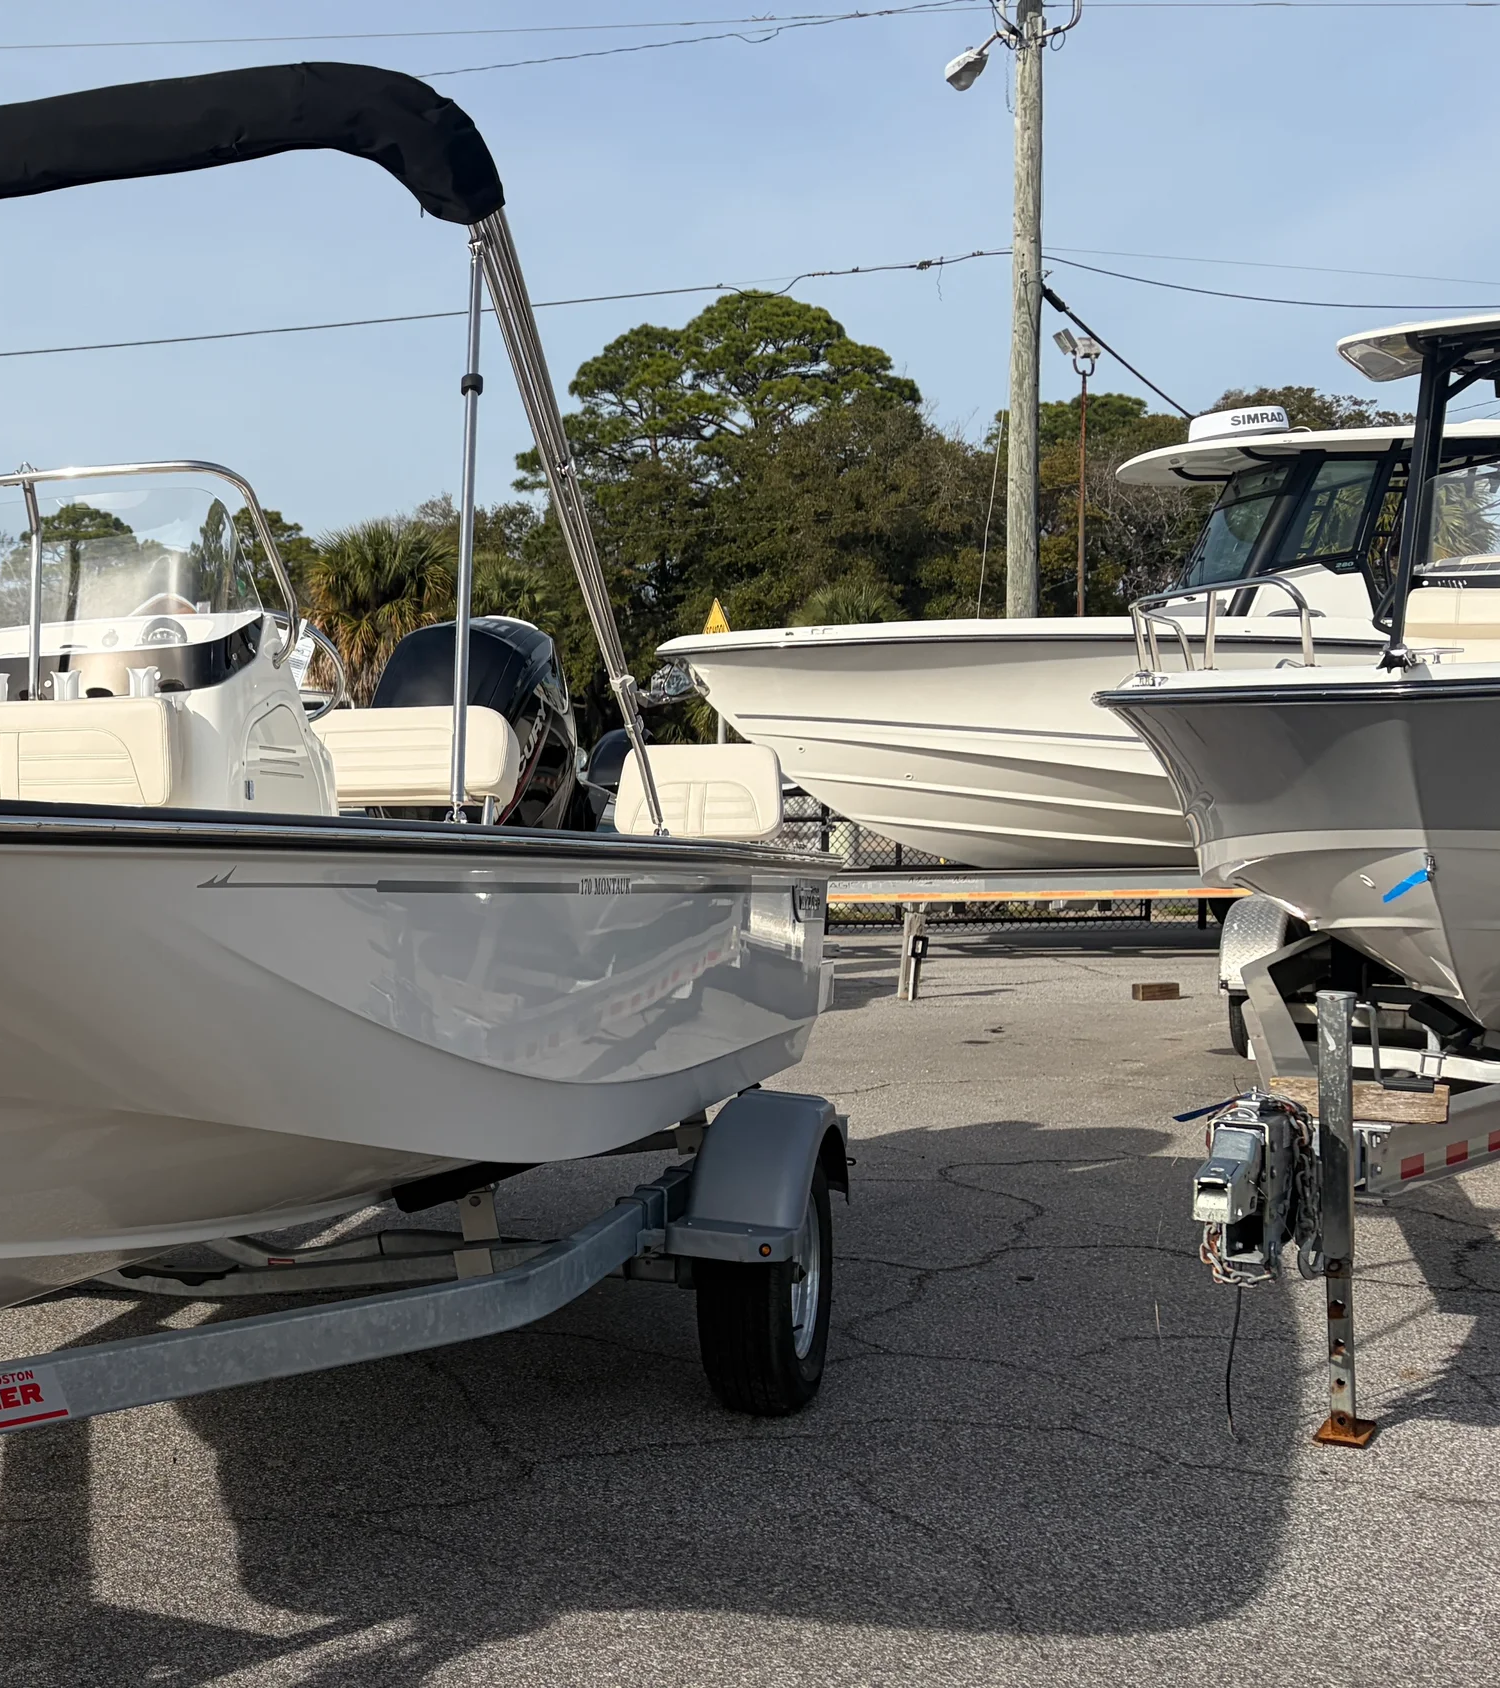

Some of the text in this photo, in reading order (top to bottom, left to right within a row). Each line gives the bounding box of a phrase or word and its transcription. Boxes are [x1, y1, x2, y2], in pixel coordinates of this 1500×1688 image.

[1230, 412, 1284, 426] SIMRAD
[518, 697, 546, 779] CURY
[581, 877, 631, 895] 170 MONTAUK
